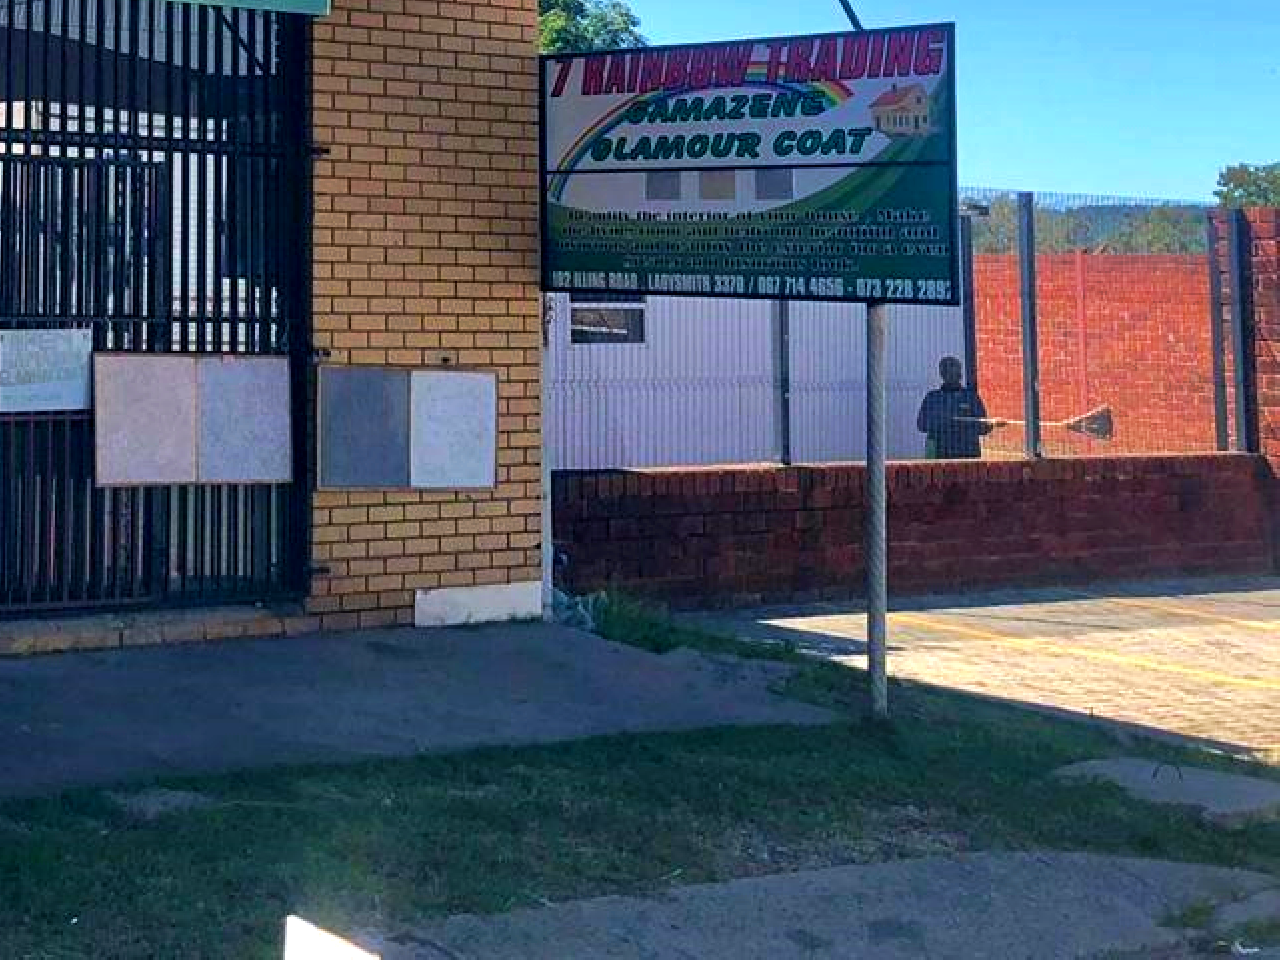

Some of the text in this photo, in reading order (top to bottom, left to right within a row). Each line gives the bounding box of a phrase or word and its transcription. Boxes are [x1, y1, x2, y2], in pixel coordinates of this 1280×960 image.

[550, 30, 946, 97] 7 RAINBOW TRADING
[621, 91, 826, 125] GAMAZENE
[591, 126, 873, 162] GLAMOUR COAT
